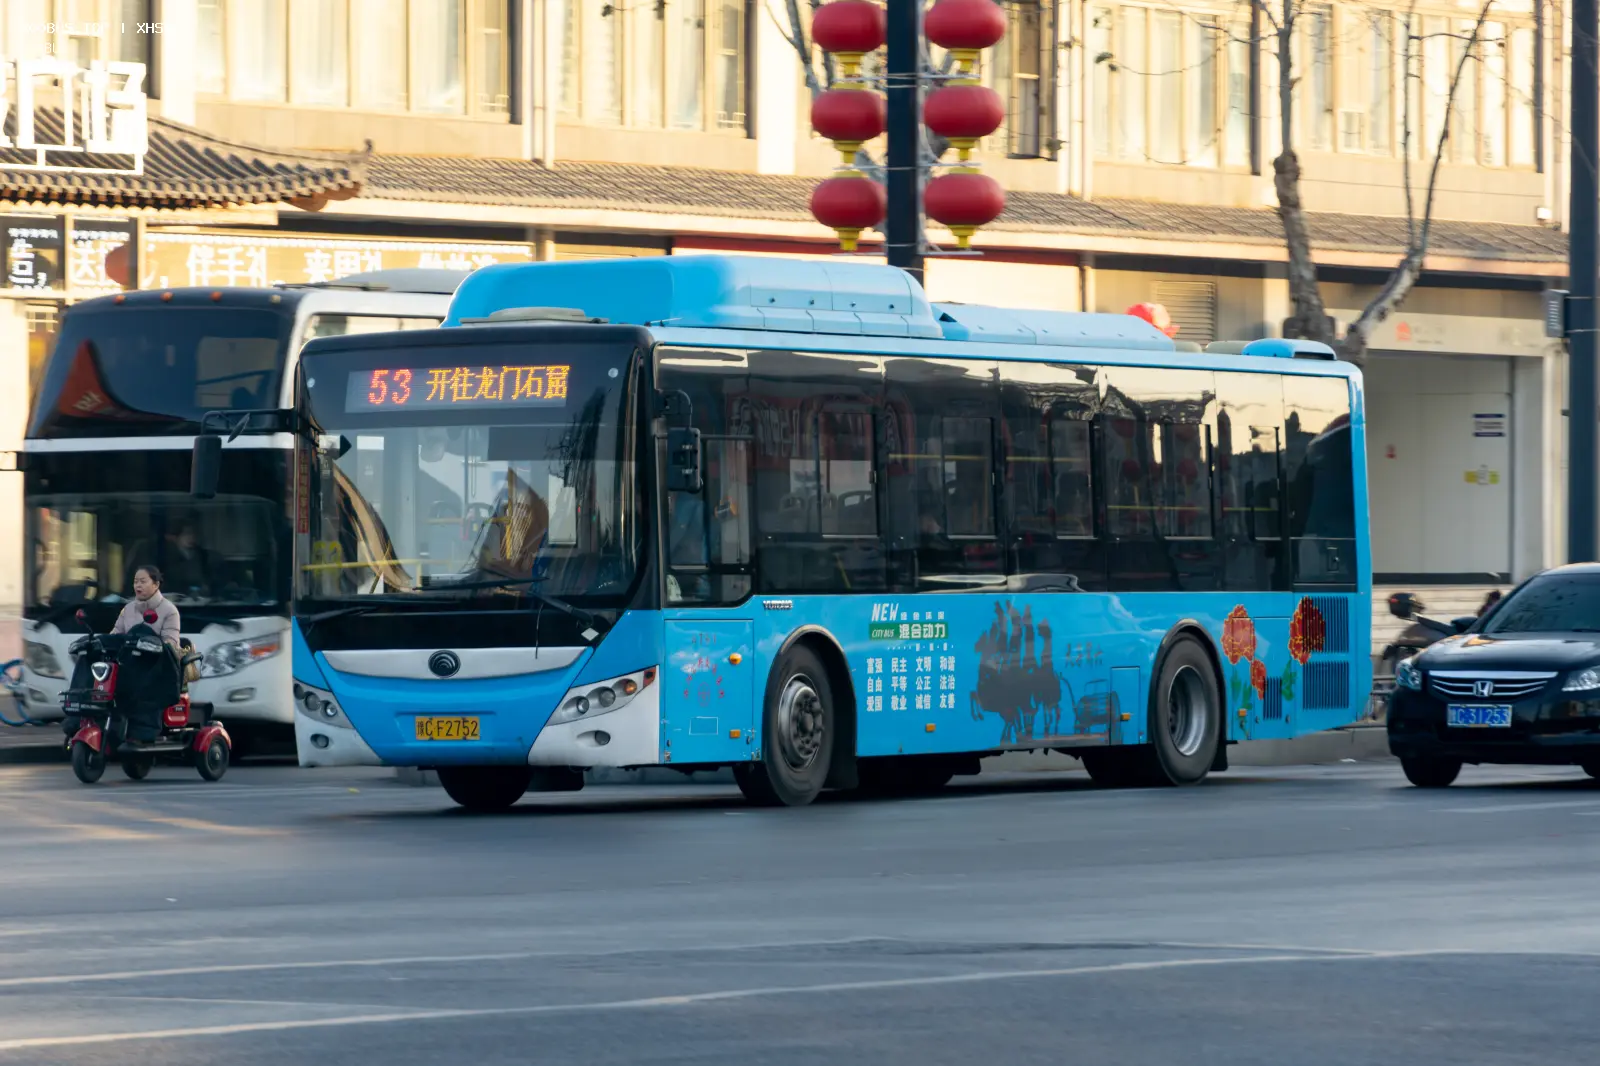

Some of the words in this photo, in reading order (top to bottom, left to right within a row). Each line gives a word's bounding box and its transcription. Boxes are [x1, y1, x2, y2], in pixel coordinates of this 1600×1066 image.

[368, 368, 413, 405] 53
[425, 364, 570, 403] 开往龙门石窟
[871, 602, 899, 622] NEW
[899, 623, 946, 639] 混合动力
[866, 657, 883, 674] 富强
[891, 657, 907, 673] 民主
[916, 656, 932, 672] 文明
[940, 655, 955, 672] 和谐
[867, 676, 882, 693] 自由
[891, 675, 907, 692] 平等
[916, 675, 931, 691] 公正
[940, 674, 955, 690] 法治
[866, 695, 883, 712] 爱国
[891, 694, 907, 711] 敬业
[915, 693, 931, 710] 诚信
[940, 692, 955, 709] 友善
